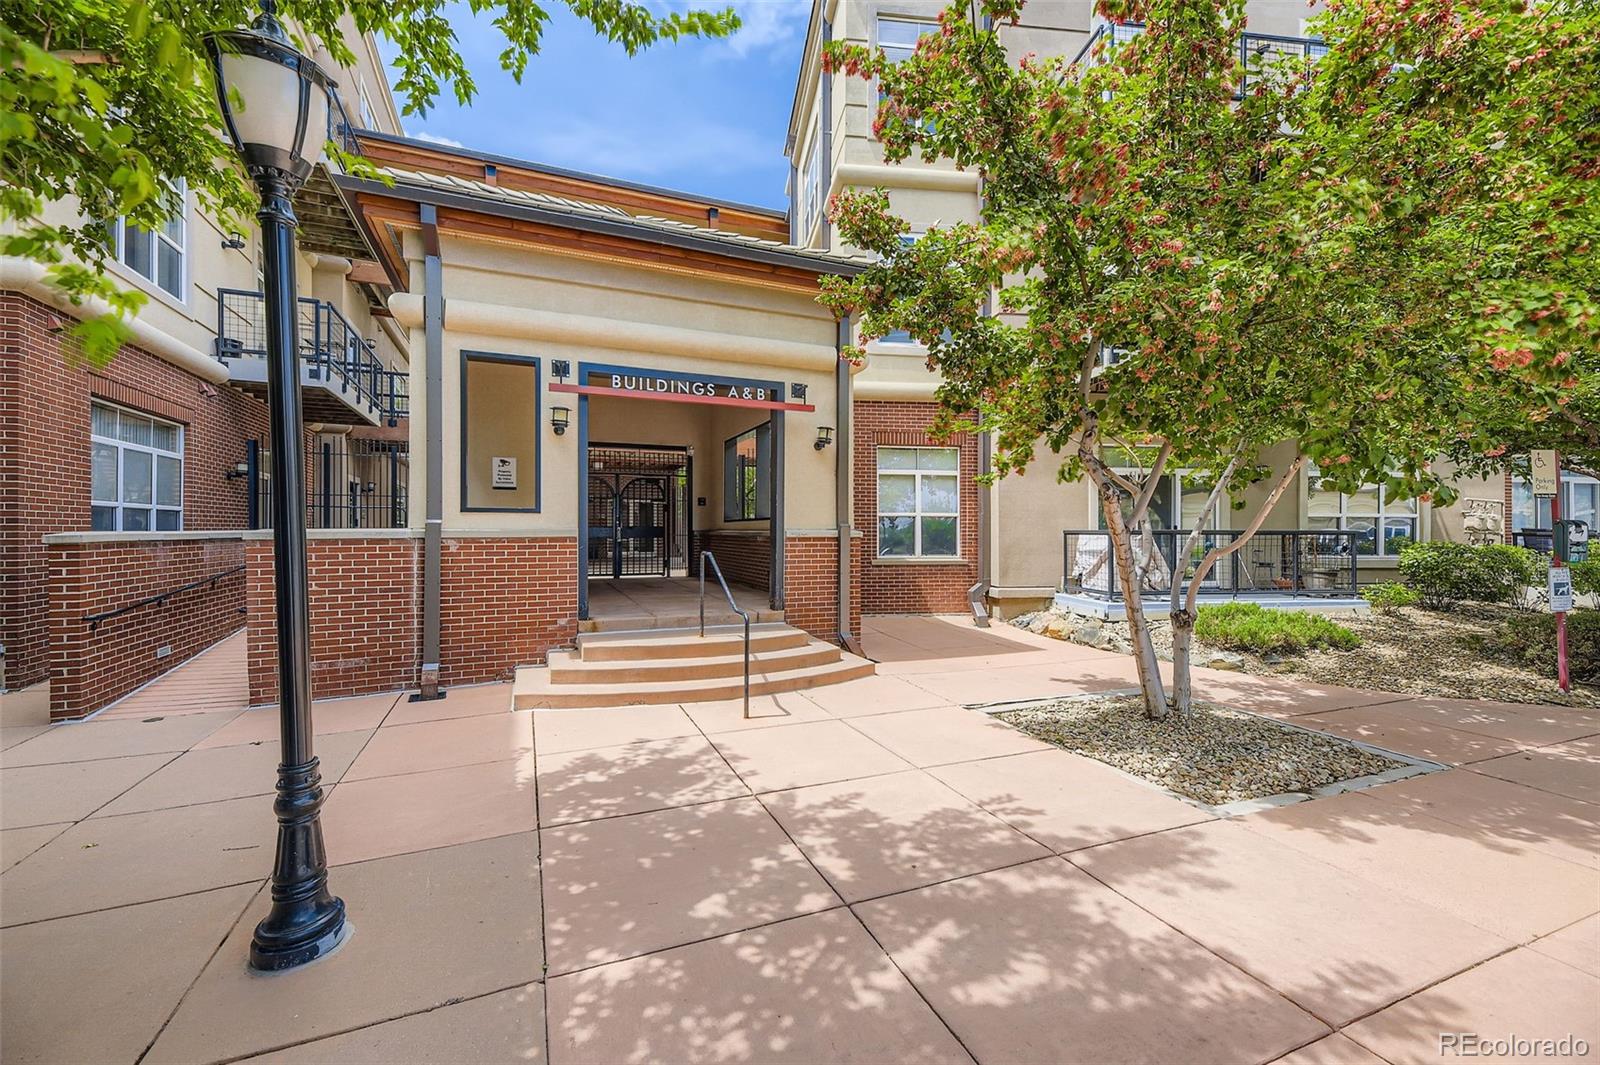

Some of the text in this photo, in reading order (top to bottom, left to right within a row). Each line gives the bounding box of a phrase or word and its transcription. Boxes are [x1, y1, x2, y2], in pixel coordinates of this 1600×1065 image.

[611, 374, 766, 401] BUILDINGS A&B
[1535, 477, 1555, 485] Parking
